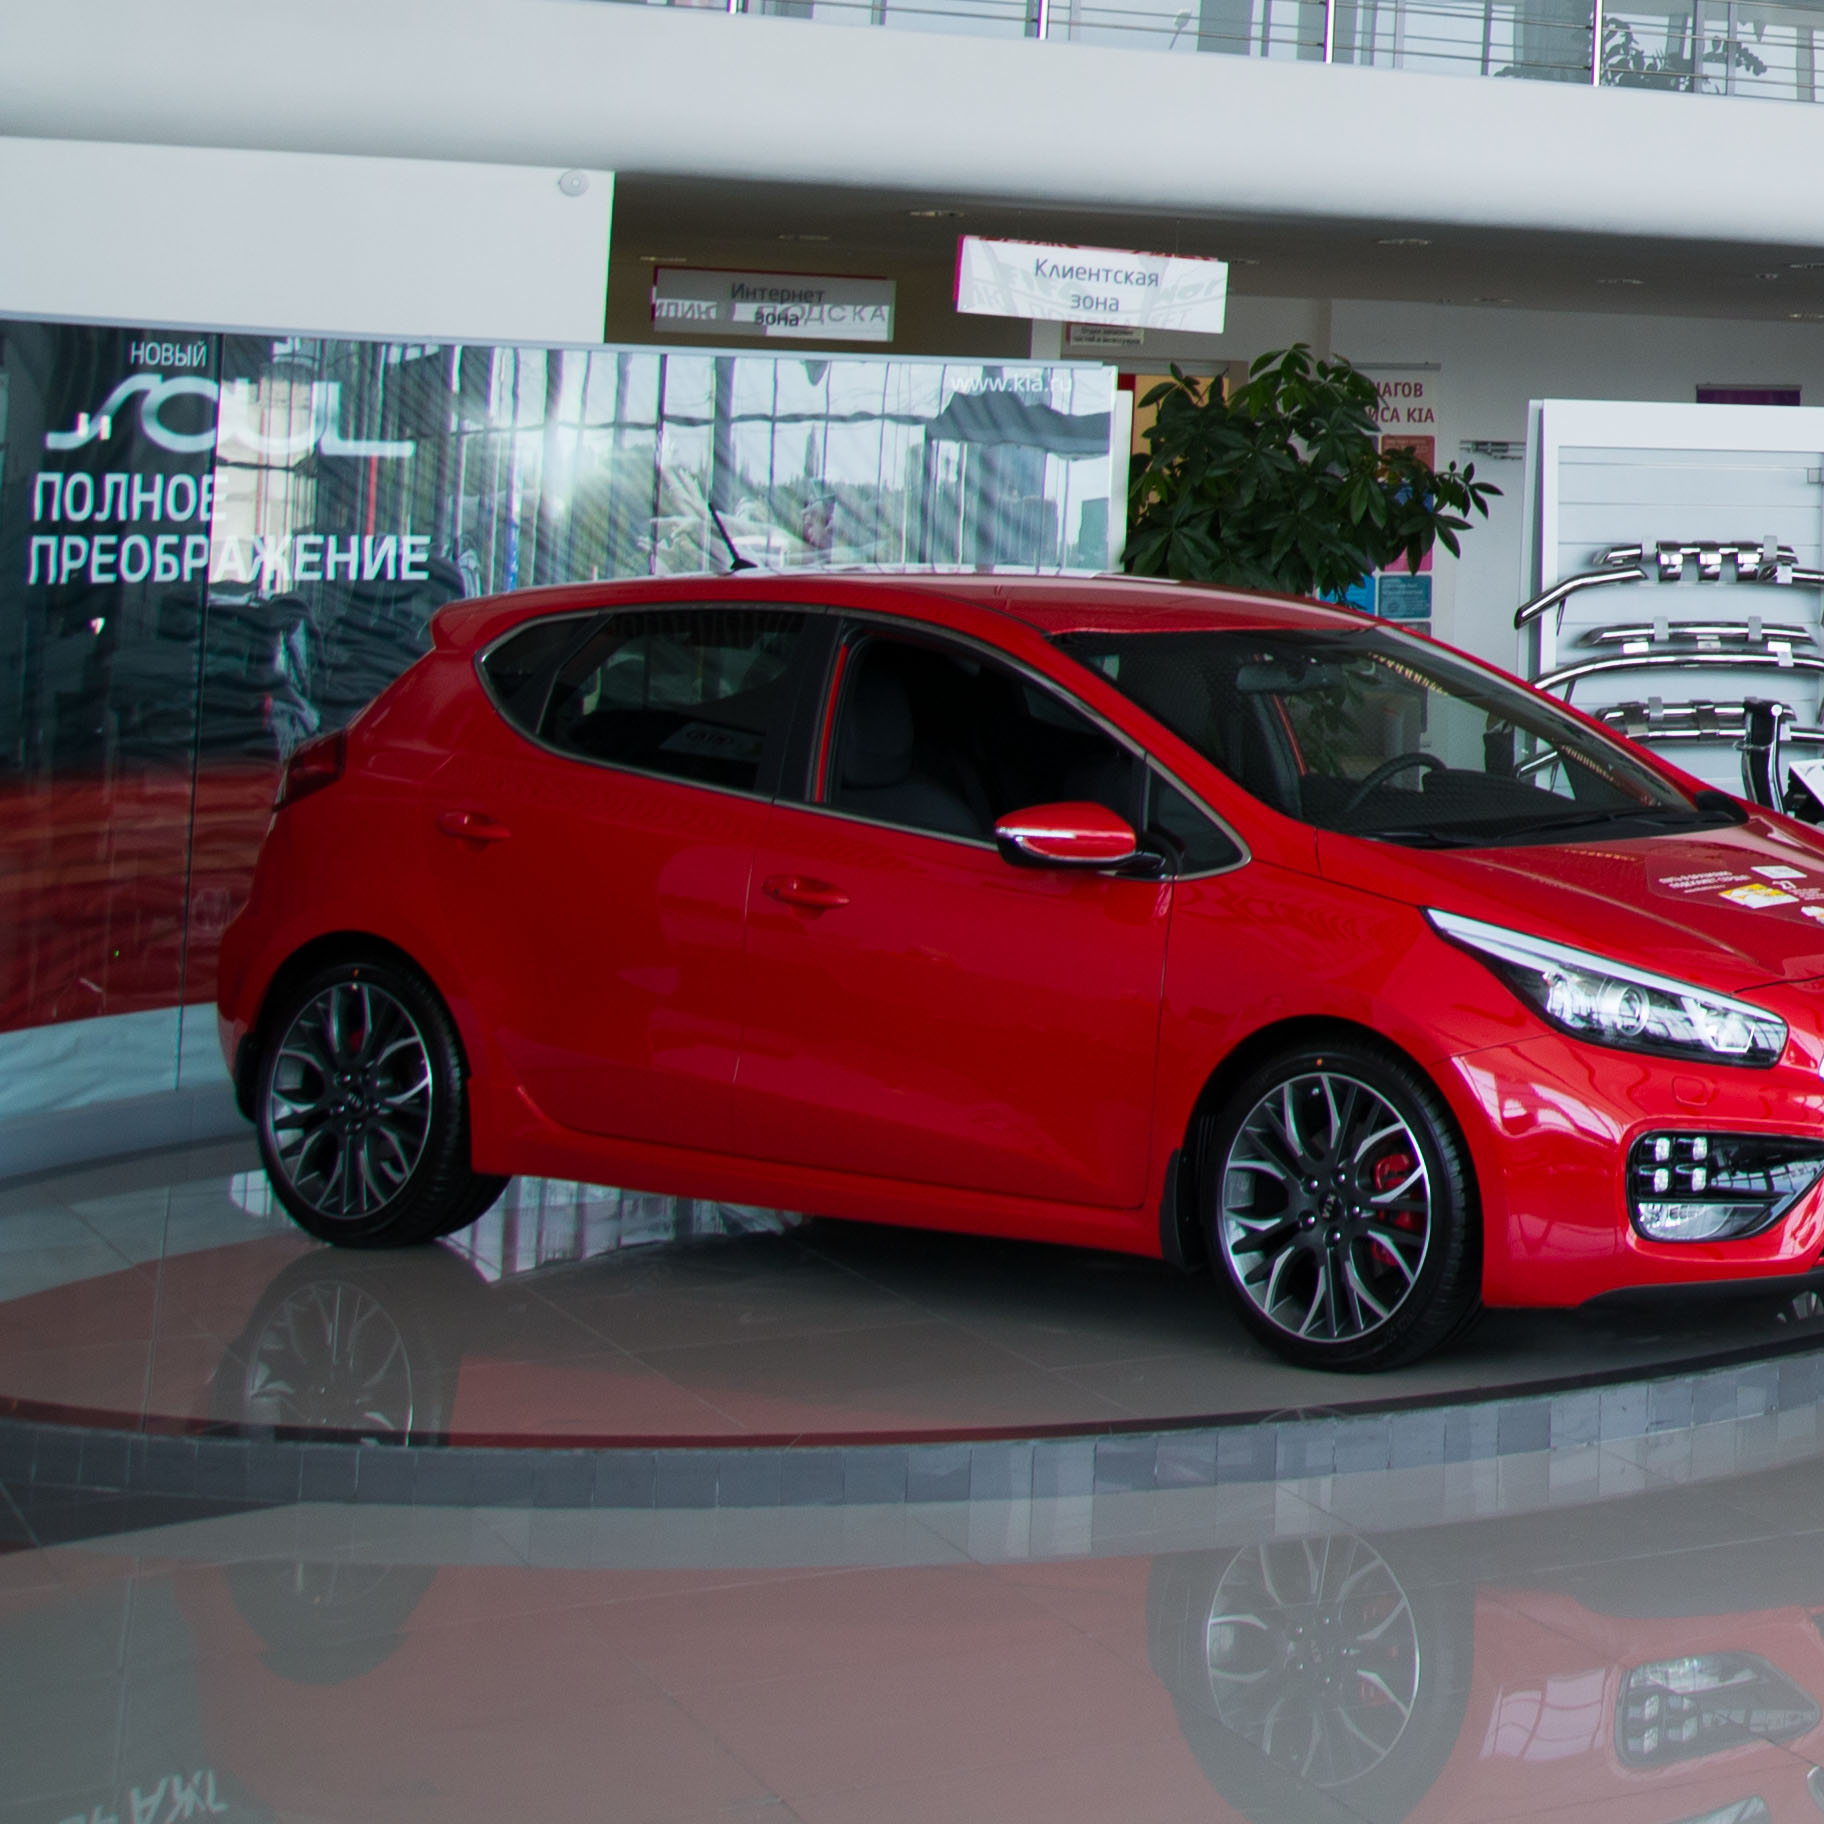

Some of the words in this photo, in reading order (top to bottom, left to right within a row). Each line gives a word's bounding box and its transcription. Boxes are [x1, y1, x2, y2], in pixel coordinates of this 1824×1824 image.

[1034, 257, 1160, 288] Клиентская
[730, 282, 826, 304] Интернет
[1070, 293, 1120, 313] зона
[753, 308, 801, 327] зона
[130, 340, 208, 368] НОВЫЙ
[950, 373, 1073, 393] www.kia.ru
[1407, 407, 1435, 423] KIA
[33, 472, 228, 522] ПОЛНОЕ
[28, 534, 431, 585] ПРЕОБРАЖЕНИЕ
